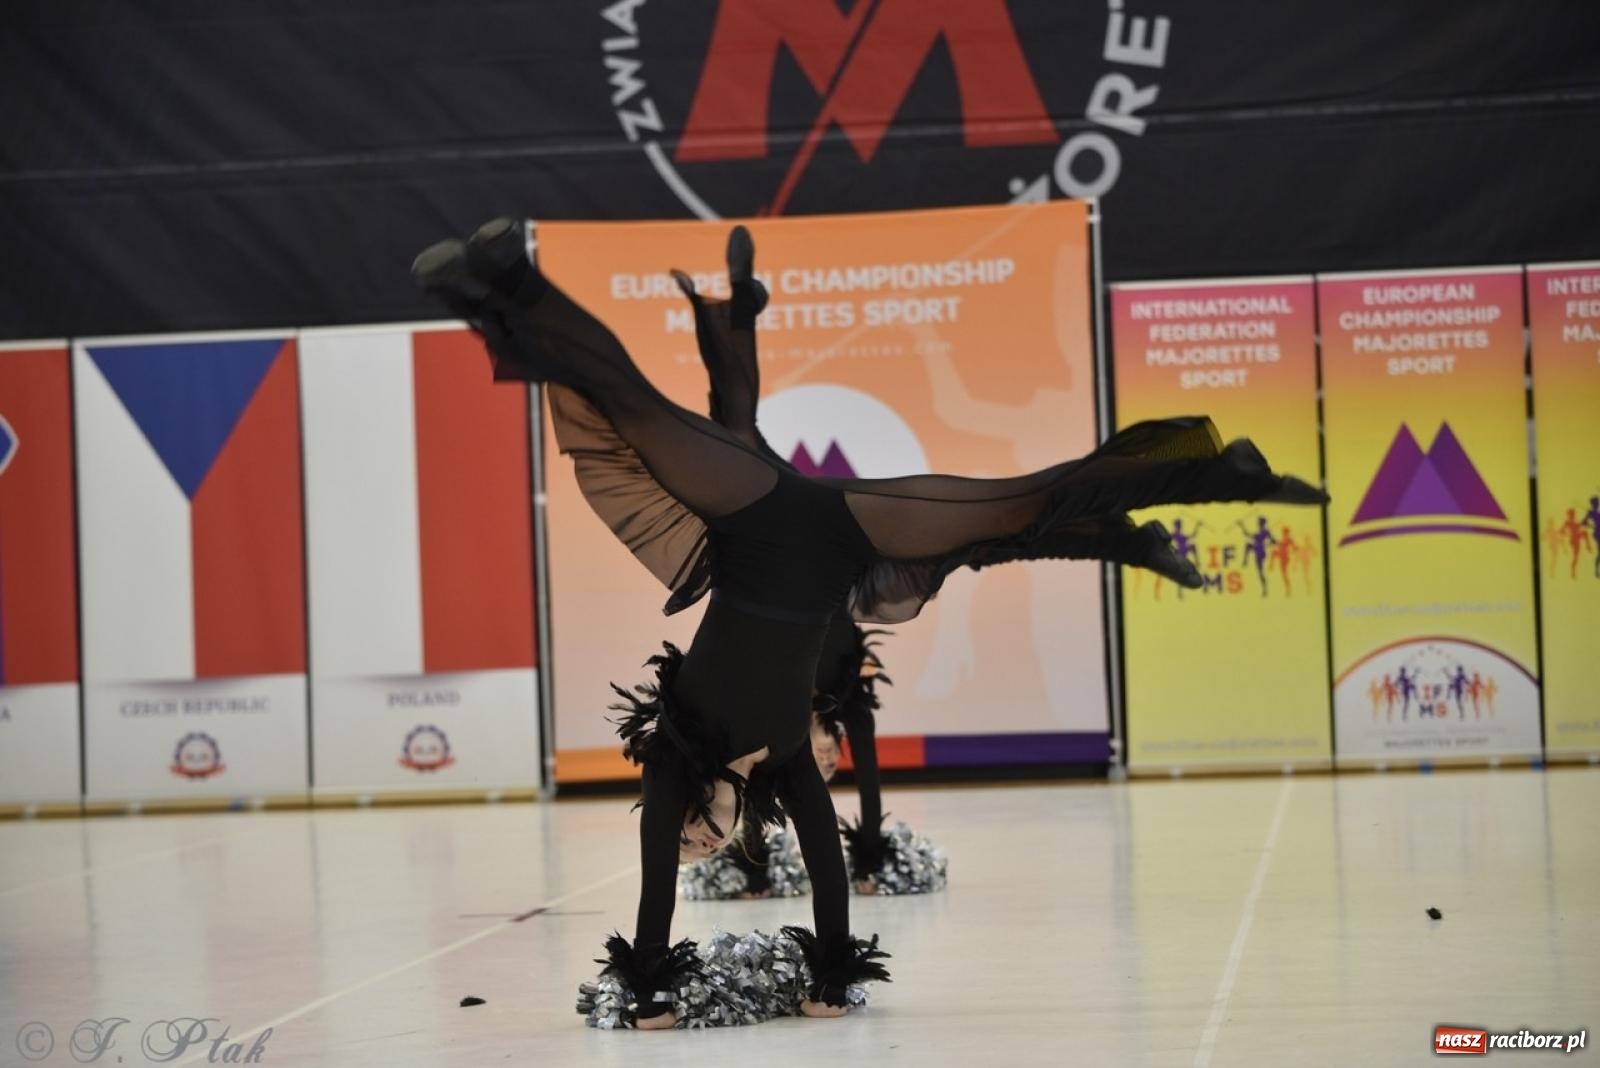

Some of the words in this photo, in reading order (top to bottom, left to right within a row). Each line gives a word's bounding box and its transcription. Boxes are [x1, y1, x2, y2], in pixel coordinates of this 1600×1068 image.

[780, 258, 1015, 295] CHAMPIONSHIP
[1362, 284, 1475, 305] EUROPEAN
[665, 305, 854, 333] METTES
[863, 297, 962, 326] SPORT
[1130, 296, 1293, 320] INTERNATIONAL
[1339, 306, 1501, 331] CHAMPIONSHIP
[1149, 322, 1275, 342] FEDERATION
[1353, 330, 1488, 353] MAJORETTES
[1146, 345, 1280, 366] MAJORETTES
[1387, 356, 1456, 375] SPORT
[1180, 369, 1248, 389] SPORT
[182, 696, 270, 715] REPUBLIC
[387, 690, 461, 707] POLAND
